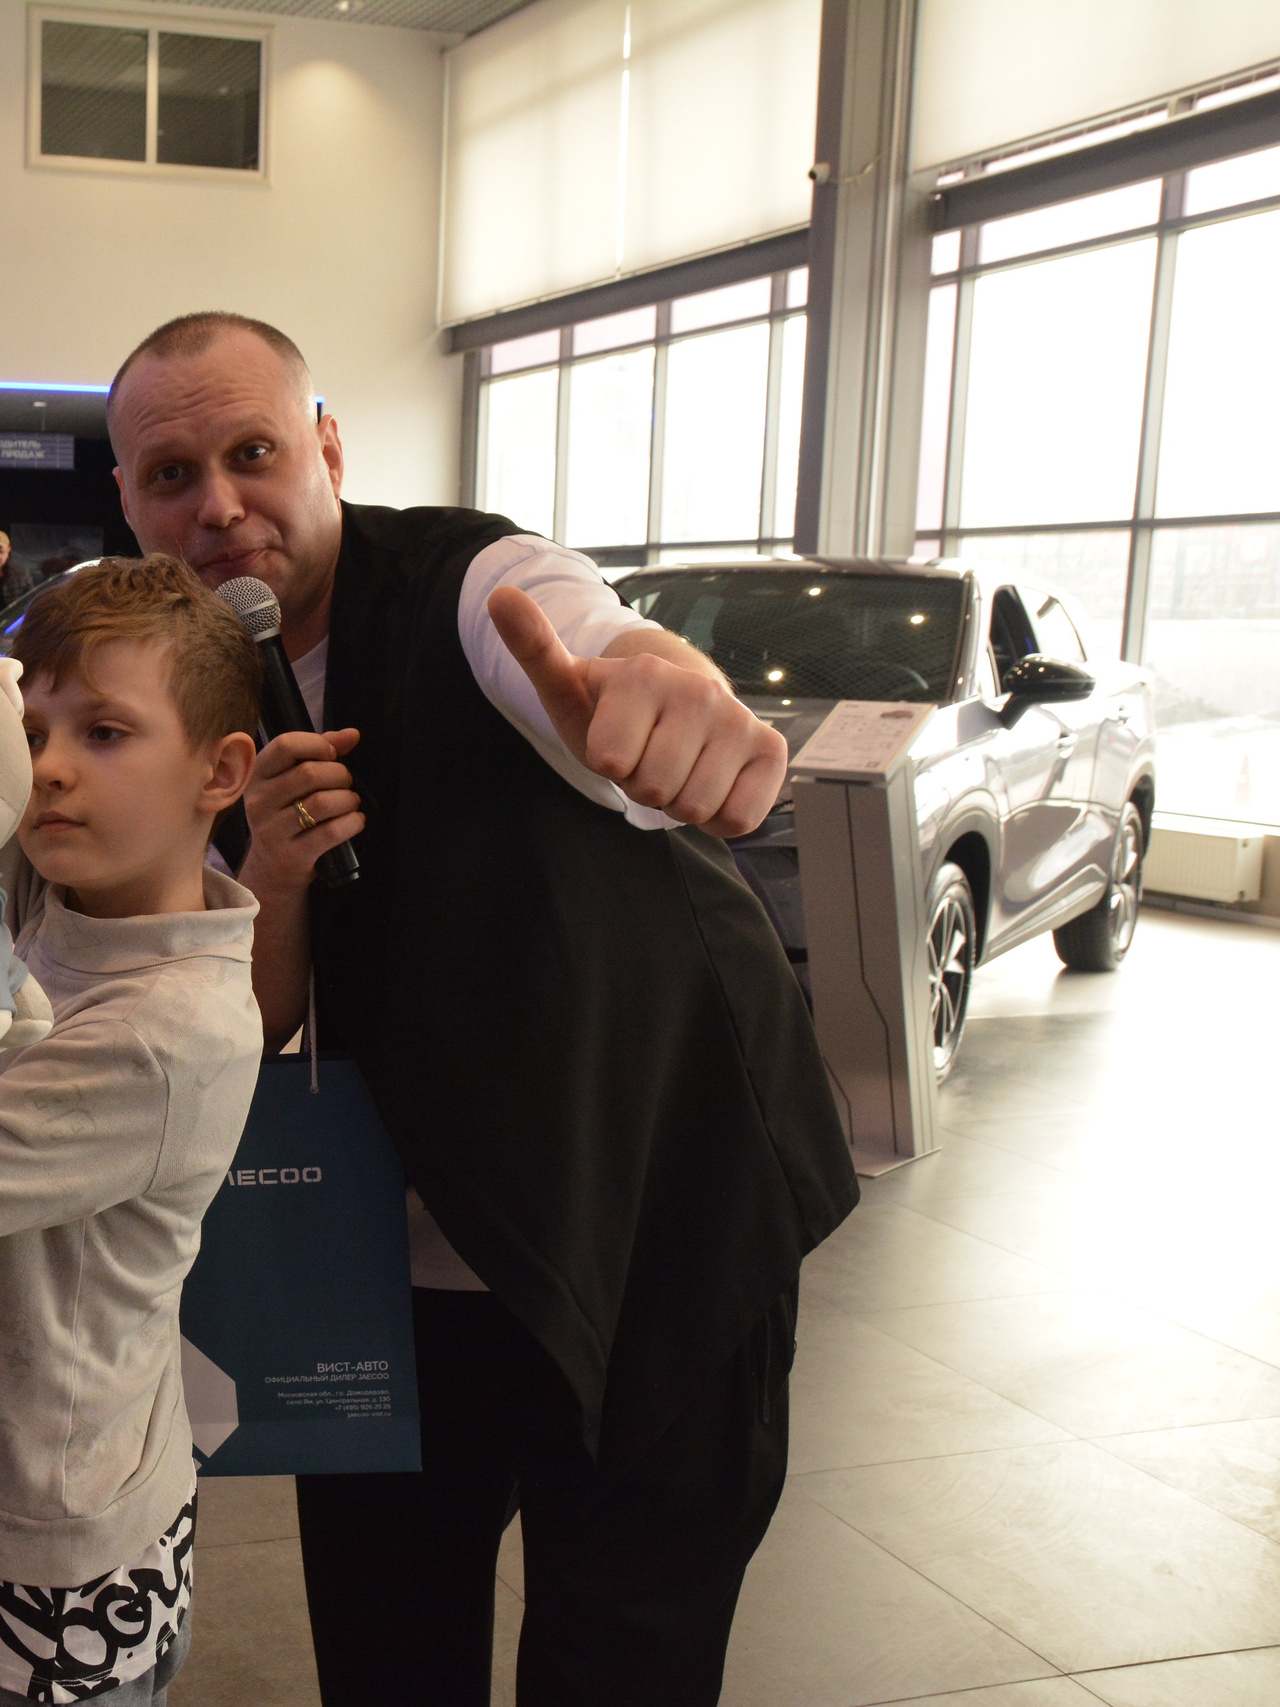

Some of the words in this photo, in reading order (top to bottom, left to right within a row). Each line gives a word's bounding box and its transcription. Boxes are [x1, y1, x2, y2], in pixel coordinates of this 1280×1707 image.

[1, 449, 45, 459] ПРОДАЖ
[317, 1361, 389, 1373] ВИСТ-АВТО
[265, 1374, 329, 1383] ОФИЦИАЛЬНЫЙ
[330, 1374, 357, 1382] ДИЛЕР
